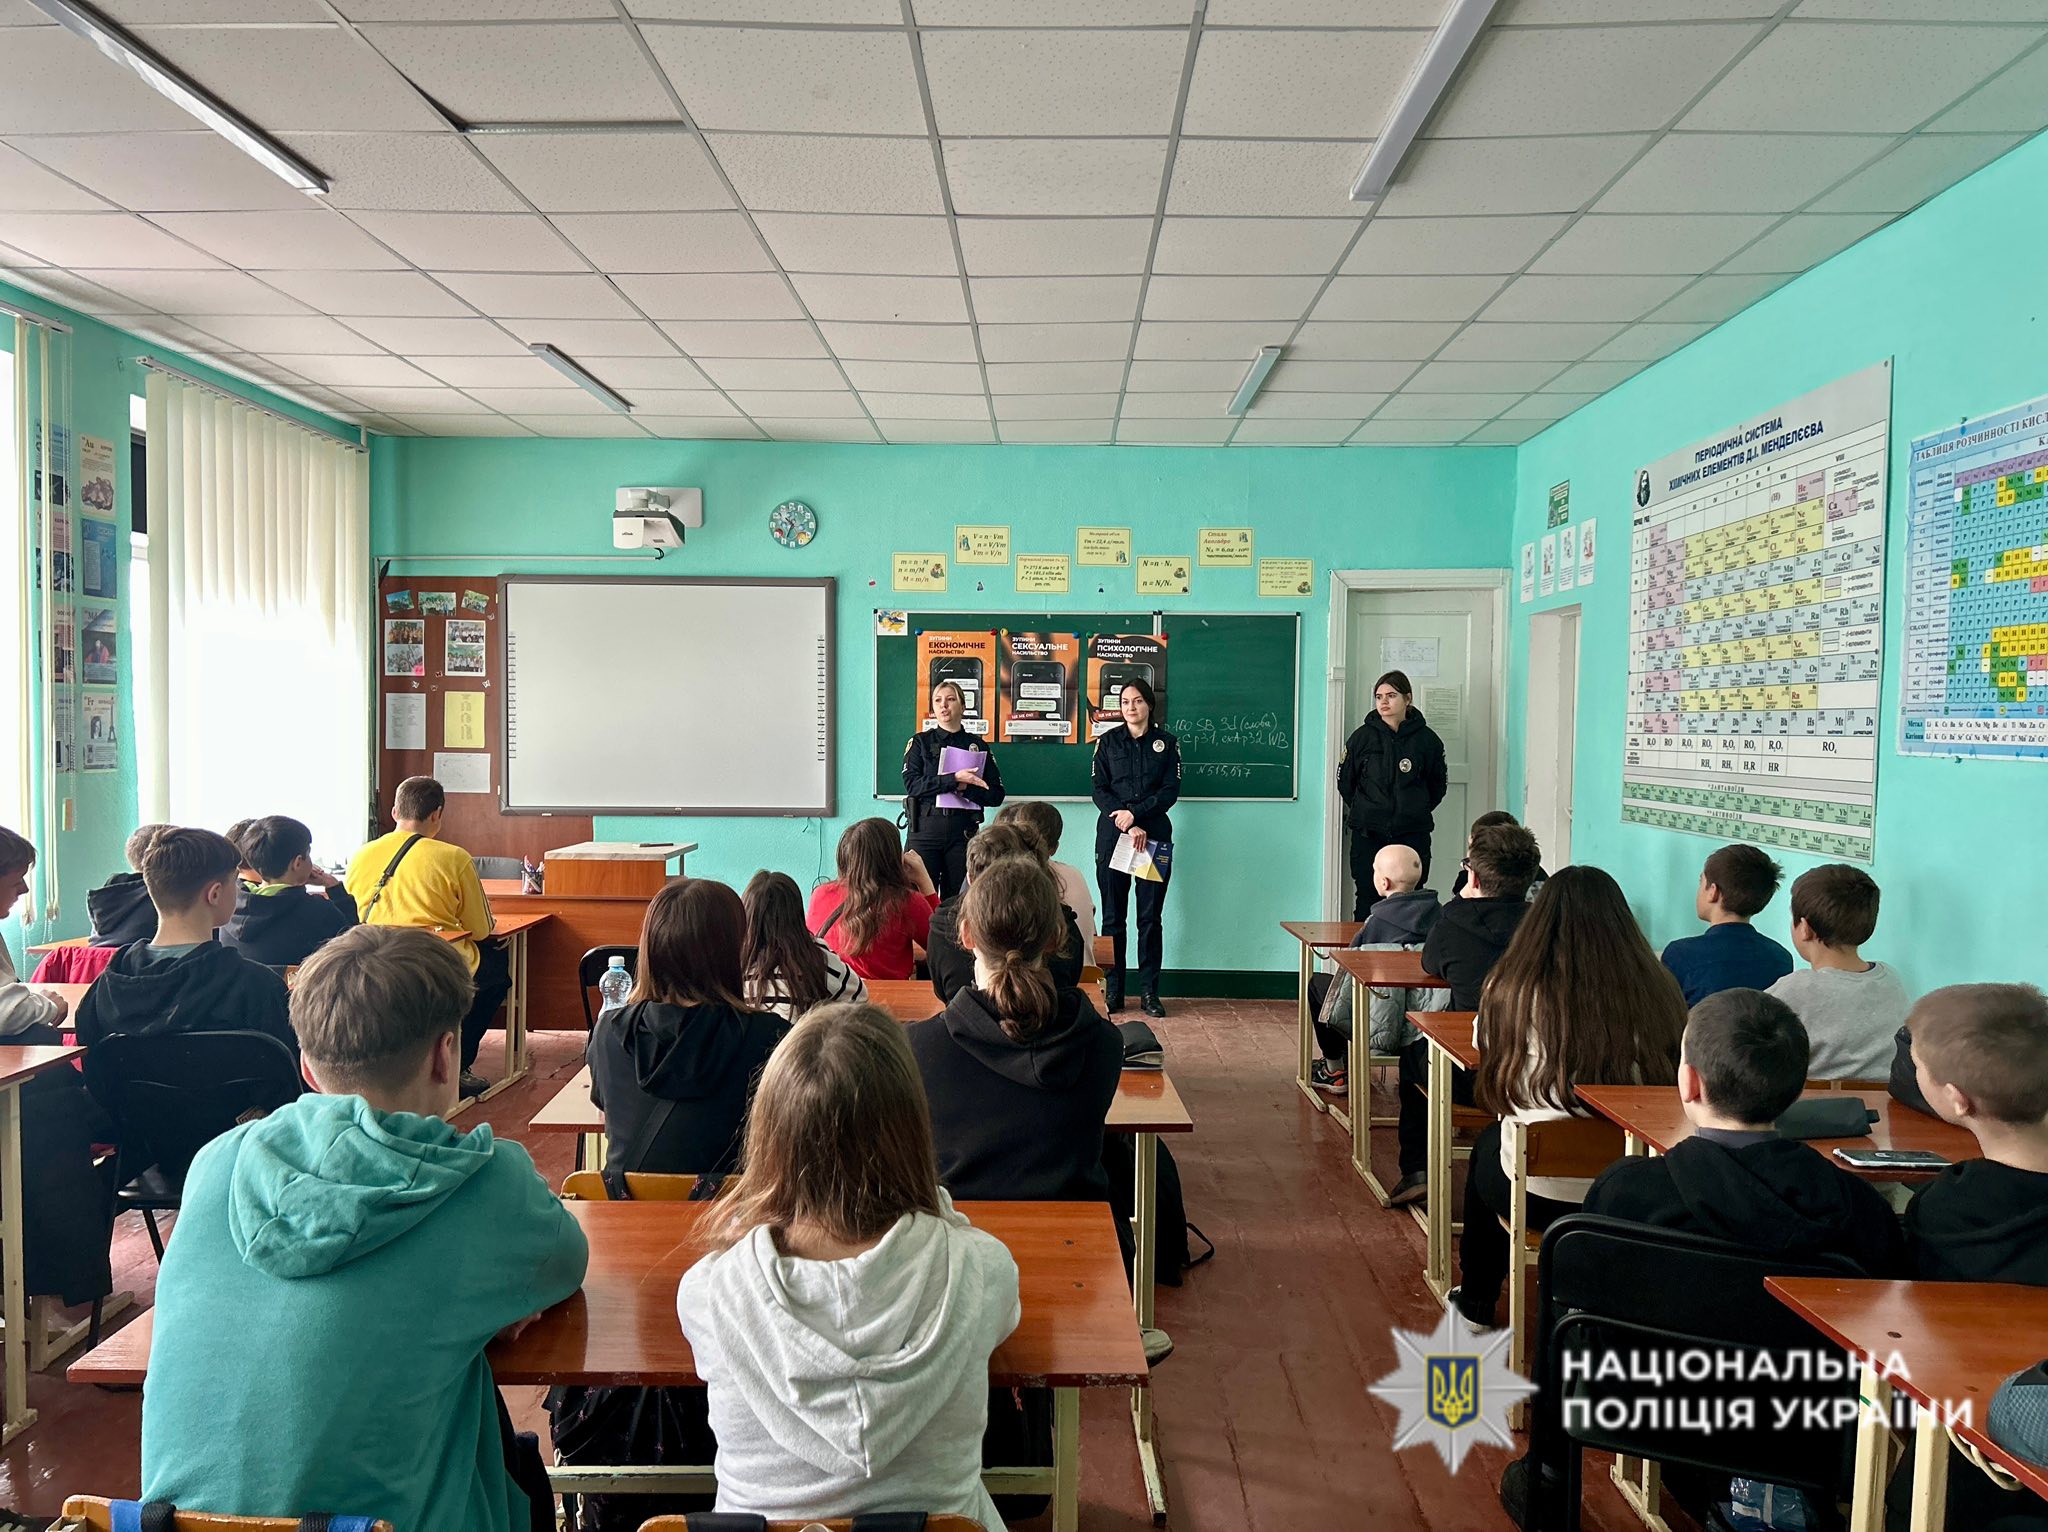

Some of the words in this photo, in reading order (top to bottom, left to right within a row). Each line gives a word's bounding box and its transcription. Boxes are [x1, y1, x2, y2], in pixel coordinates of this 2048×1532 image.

[1695, 434, 1743, 464] ПЕРІОДИЧНА
[1744, 416, 1783, 444] СИСТЕМА
[1916, 443, 1954, 461] ТАБЛИЦЯ
[1956, 422, 2019, 449] РОЗЧИННОСТІ
[1669, 468, 1701, 491] ХІМІЧНИХ
[1702, 450, 1745, 478] ЕЛЕМЕНТІВ
[1746, 446, 1759, 463] Д.І.
[1760, 420, 1824, 455] МЕНДЕЛЄЄВА
[1798, 484, 1807, 493] He
[1828, 502, 1838, 510] Ca
[1842, 552, 1851, 561] Co
[1840, 608, 1849, 616] Rh
[1870, 602, 1878, 612] Pd
[1097, 645, 1158, 653] ПСИХОЛОГІЧНЕ
[1810, 665, 1818, 673] Os
[1870, 659, 1878, 668] Pt
[1196, 718, 1215, 732] SB
[1808, 717, 1815, 726] Hs
[1835, 717, 1844, 726] Mt
[1866, 717, 1874, 726] Ds
[1269, 732, 1289, 749] WB
[1768, 762, 1780, 772] HR
